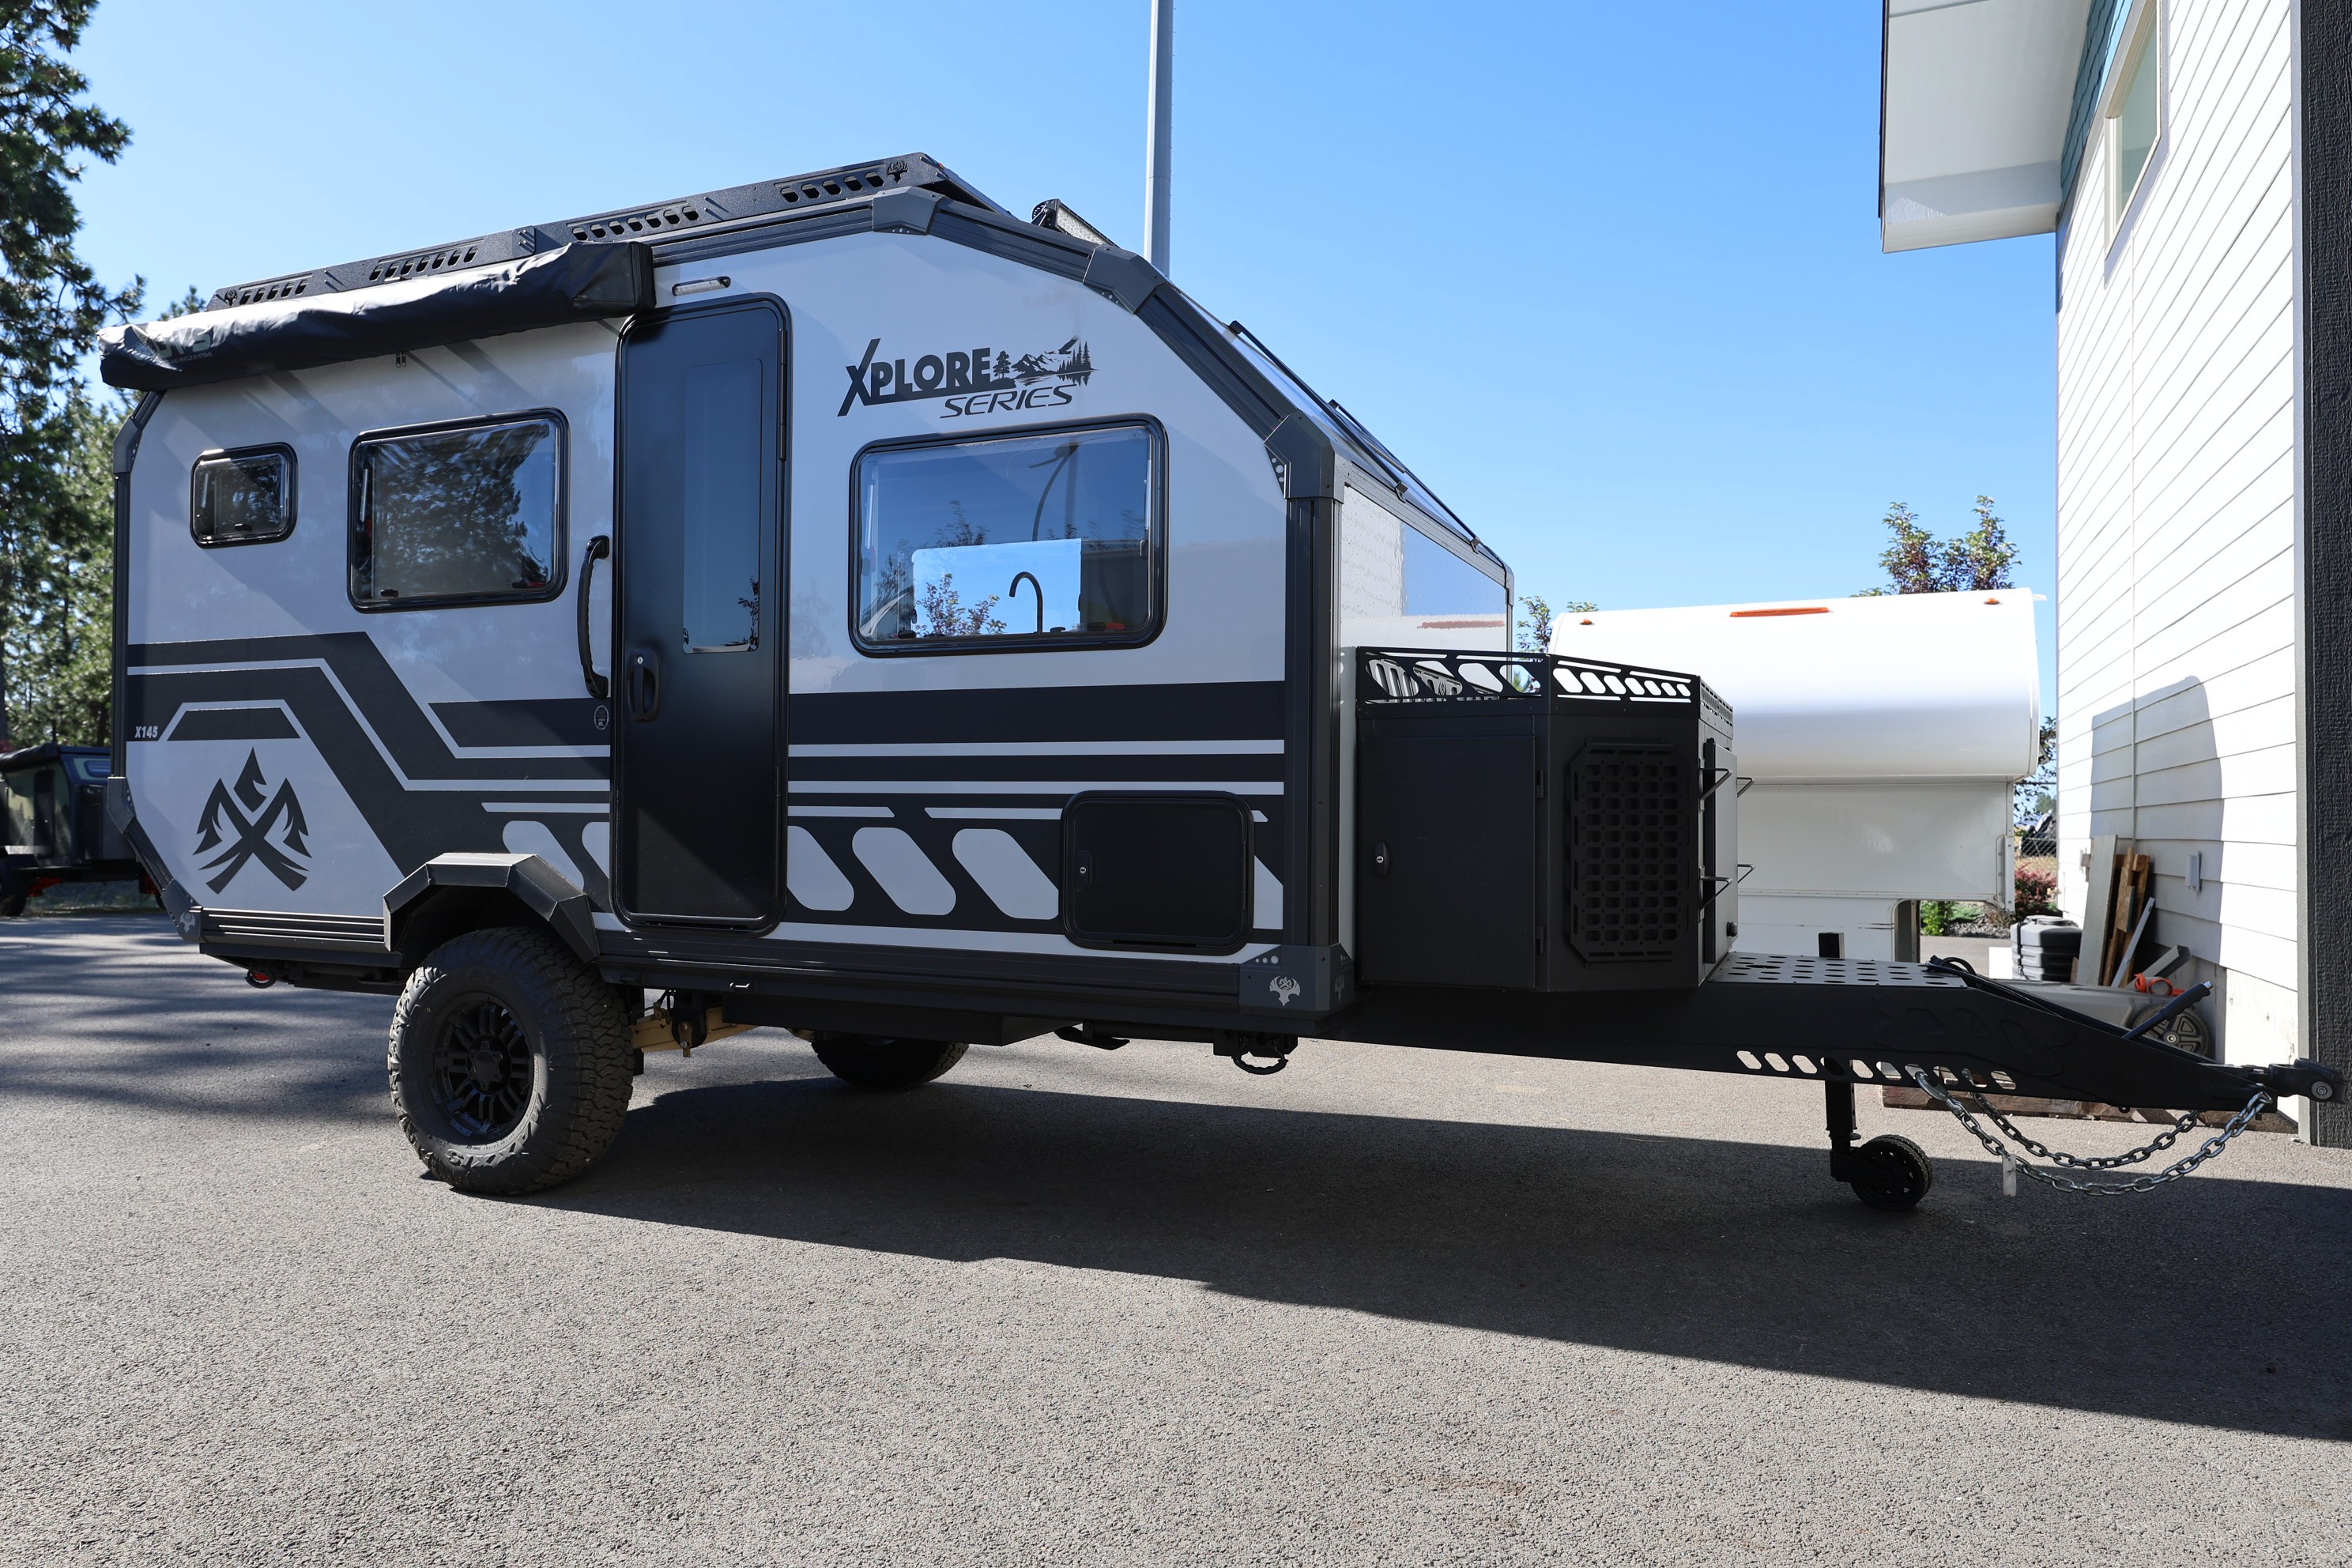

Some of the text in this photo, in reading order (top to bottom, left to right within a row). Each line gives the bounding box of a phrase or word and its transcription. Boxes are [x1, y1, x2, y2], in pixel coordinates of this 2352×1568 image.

[837, 338, 991, 416] XPLORE
[940, 384, 1077, 419] SERIES
[134, 726, 158, 738] X145
